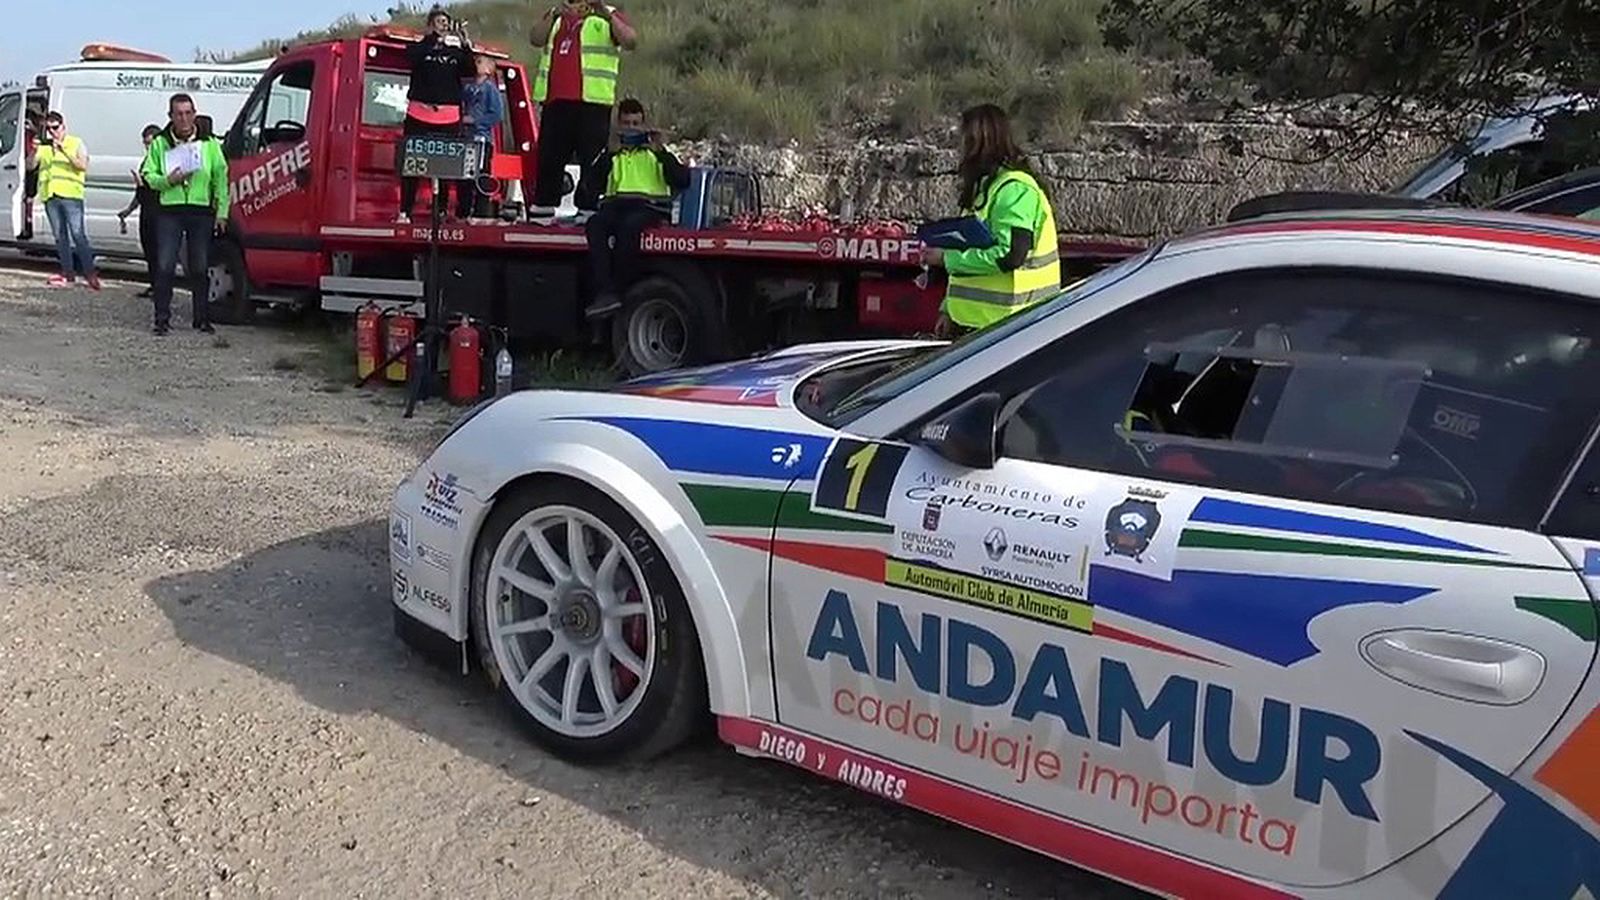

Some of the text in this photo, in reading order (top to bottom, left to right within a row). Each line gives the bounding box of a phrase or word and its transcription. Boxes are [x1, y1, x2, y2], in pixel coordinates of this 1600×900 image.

[412, 228, 465, 241] mapre.es
[640, 232, 696, 251] idamos
[835, 238, 921, 261] MAPF
[845, 443, 879, 511] 1
[915, 472, 1086, 509] Ayuntamiento de
[905, 487, 1080, 529] Carboneras
[1012, 544, 1071, 563] RENAULT
[905, 567, 964, 595] Automóvil
[967, 580, 995, 601] Club
[807, 590, 1381, 821] ANDAMUR
[759, 731, 806, 763] DIEGO
[837, 759, 907, 799] ANDRES
[834, 684, 939, 744] cada
[1079, 750, 1297, 856] importa
